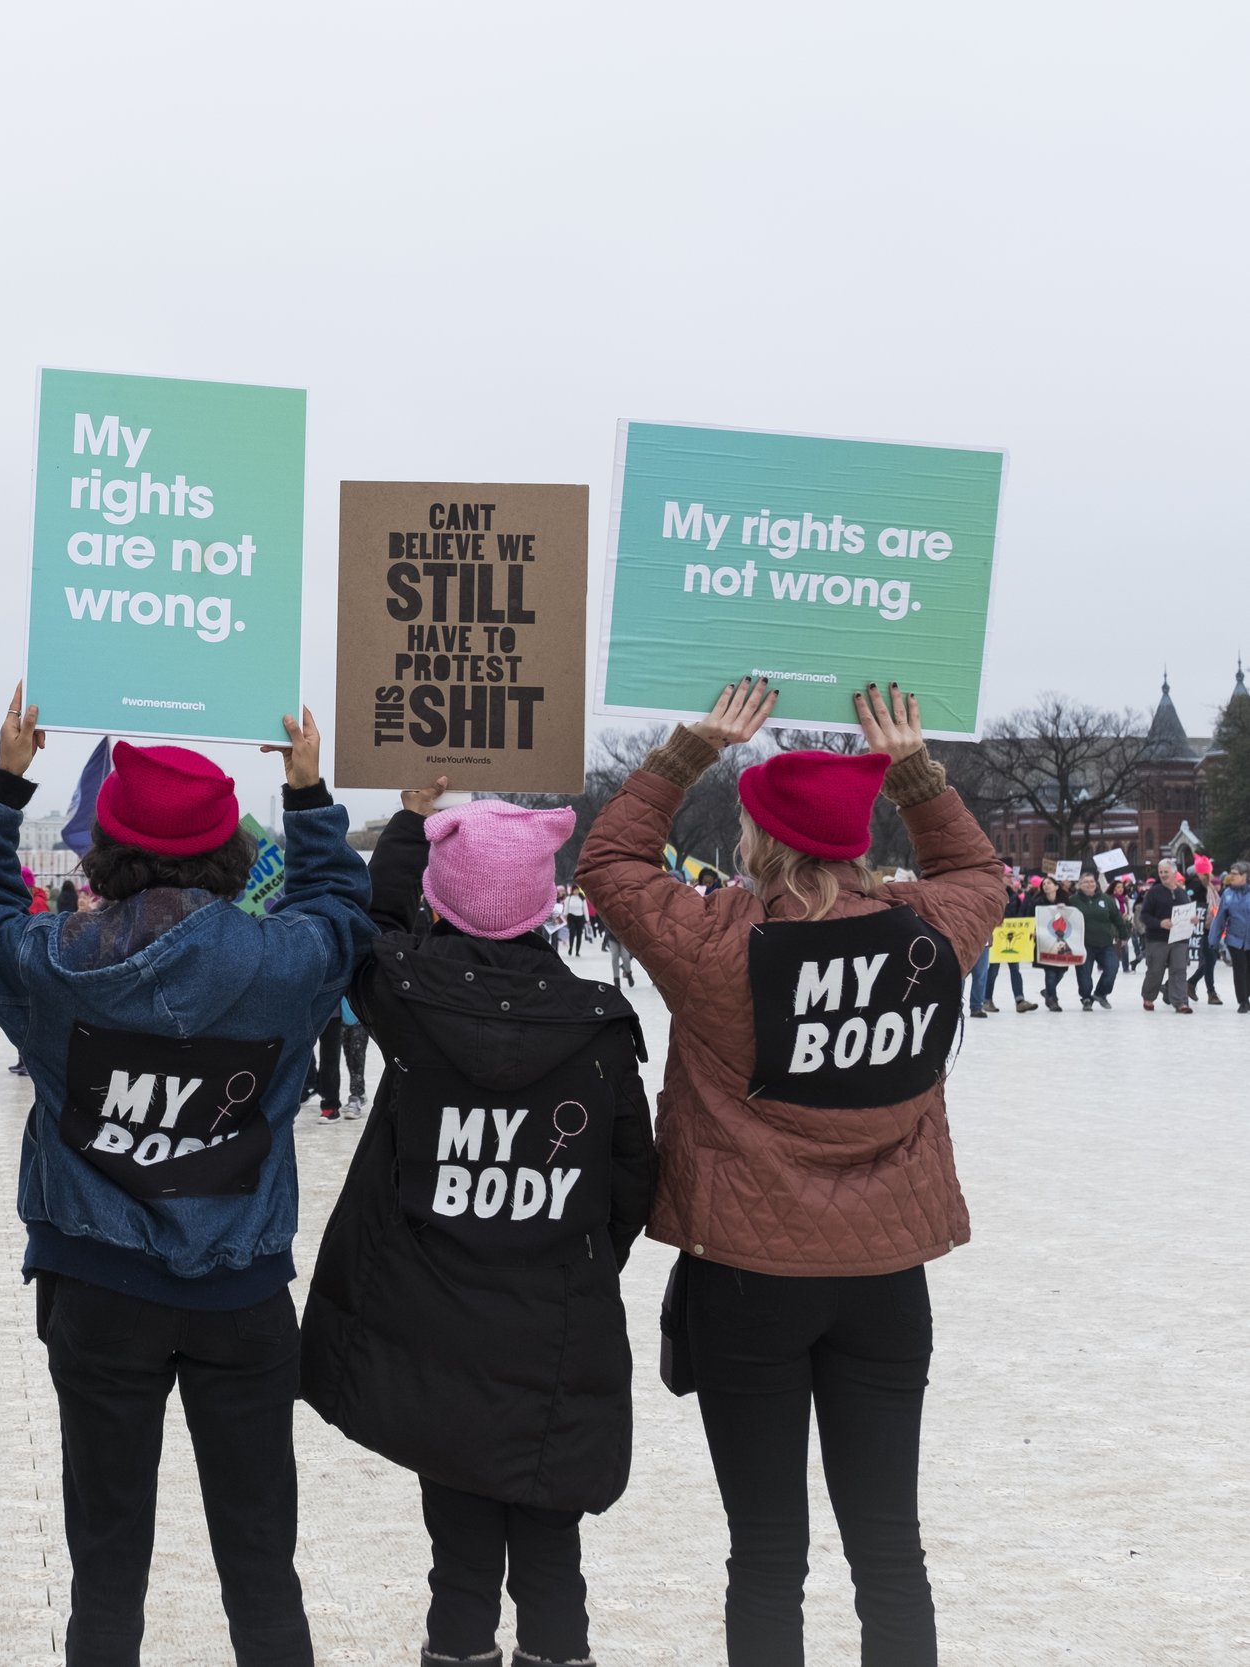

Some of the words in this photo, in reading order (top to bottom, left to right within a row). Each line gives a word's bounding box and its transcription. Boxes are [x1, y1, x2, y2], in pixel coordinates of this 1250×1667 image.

[73, 413, 152, 467] My
[70, 469, 215, 525] rights
[429, 503, 495, 531] CANT
[67, 531, 156, 569] are
[172, 534, 257, 576] not
[389, 532, 485, 560] BELIEVE
[497, 534, 536, 561] WE
[662, 501, 731, 551] My
[741, 509, 866, 559] rights
[877, 527, 954, 561] are
[64, 586, 246, 643] wrong.
[386, 562, 536, 624] STILL
[683, 560, 758, 597] not
[769, 570, 922, 621] wrong.
[407, 625, 472, 653] HAVE
[483, 626, 516, 653] TO
[395, 654, 522, 683] PROTEST
[752, 668, 837, 683] #womensmarch
[122, 696, 206, 711] #womensmarch
[374, 685, 405, 747] THIS
[408, 685, 544, 750] SHIT
[425, 755, 491, 765] #UseYourWords
[794, 952, 890, 1016] MY
[788, 1002, 940, 1074] BODY
[101, 1069, 203, 1128] MY
[436, 1106, 529, 1162] MY
[432, 1164, 582, 1221] BODY
